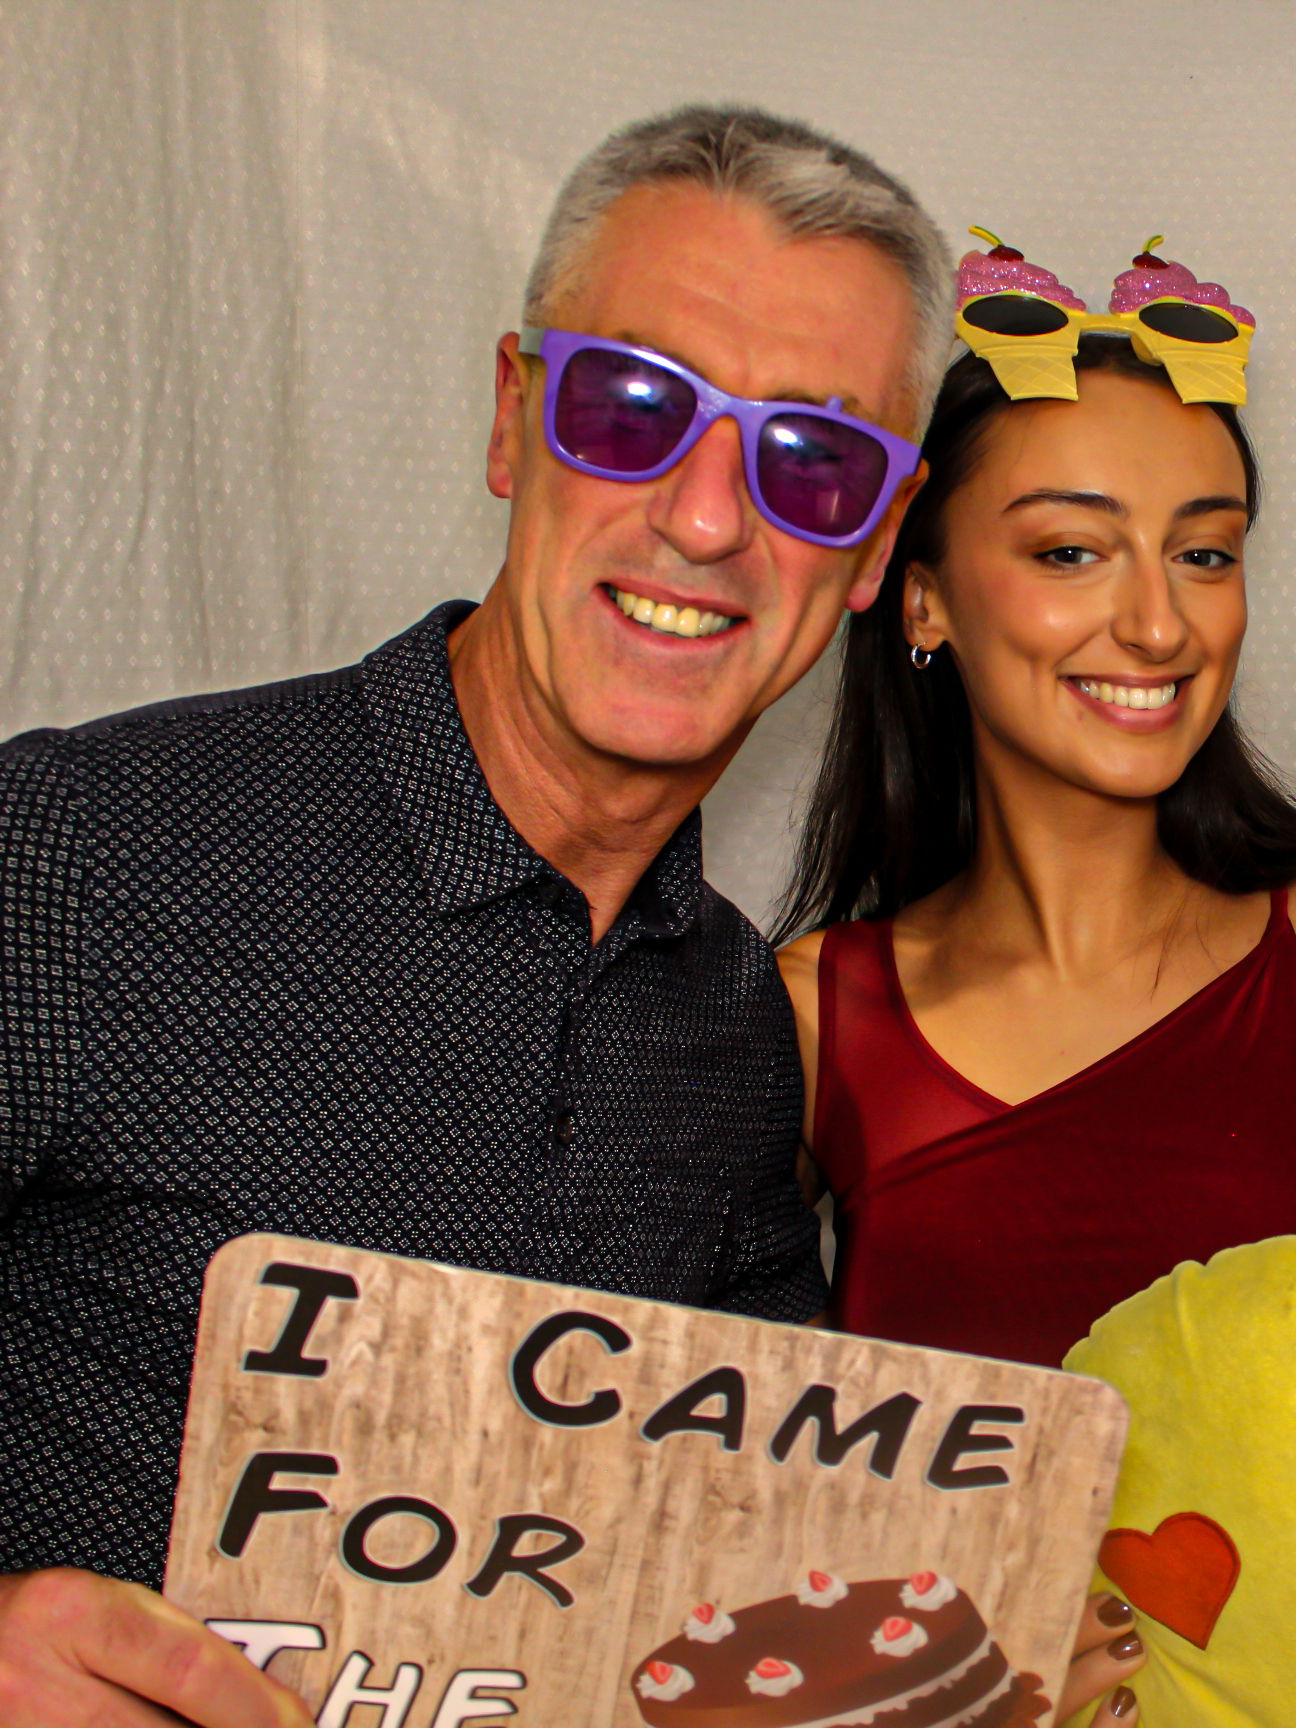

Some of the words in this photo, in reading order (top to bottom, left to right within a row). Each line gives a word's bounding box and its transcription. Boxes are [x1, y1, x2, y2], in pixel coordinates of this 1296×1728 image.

[242, 1261, 359, 1377] I
[508, 1309, 1026, 1491] CAME
[216, 1452, 586, 1610] FOR
